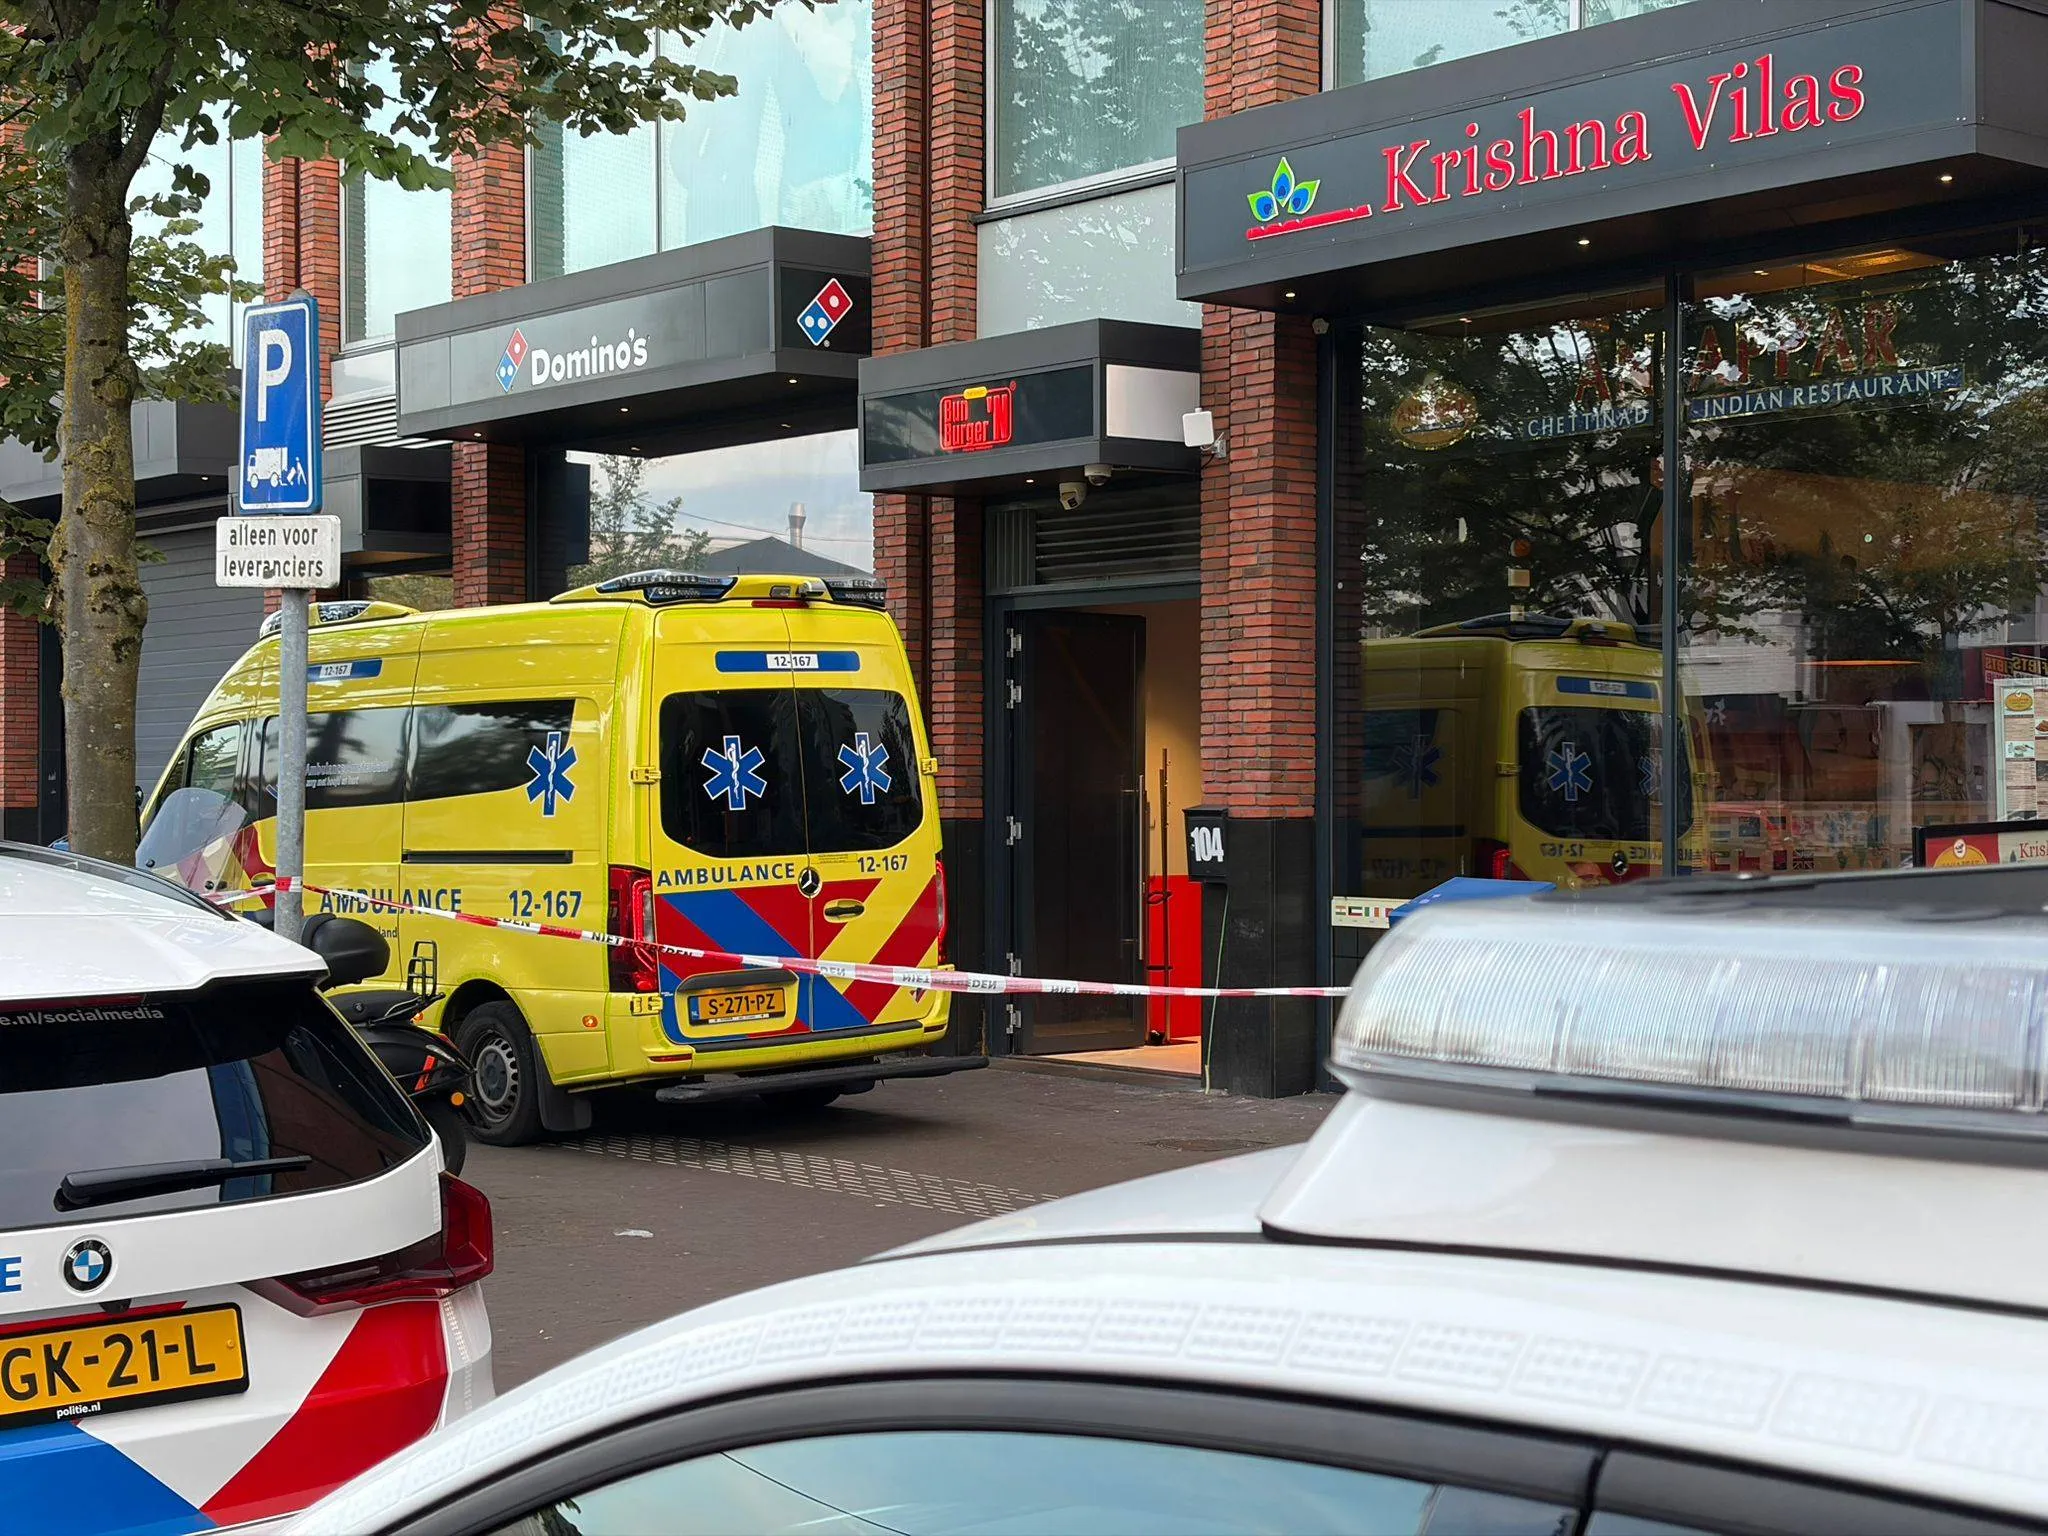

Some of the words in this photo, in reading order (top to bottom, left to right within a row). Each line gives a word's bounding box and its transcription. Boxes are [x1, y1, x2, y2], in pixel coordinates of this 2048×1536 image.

[1381, 106, 1653, 213] Krishna
[1670, 53, 1866, 152] Vilas
[531, 327, 649, 386] Domino's
[257, 329, 292, 421] P
[1703, 389, 1784, 418] INDIAN
[1792, 369, 1946, 407] RESTAURANT
[944, 398, 969, 423] Bun
[1527, 408, 1650, 438] CHETTINAD
[944, 420, 989, 447] Burger
[229, 523, 277, 546] alleen
[282, 527, 319, 546] voor
[223, 554, 324, 579] leveranciers
[323, 664, 348, 676] 12-167
[773, 655, 812, 667] 12-167
[1190, 826, 1225, 862] 104
[656, 862, 796, 887] AMBULANCE
[857, 854, 908, 873] 12-167
[320, 888, 462, 915] AMBULANCE
[508, 890, 583, 918] 12-167
[376, 925, 398, 939] land
[591, 931, 622, 946] NIET
[0, 1006, 165, 1026] e.nl/socialmedia
[708, 993, 776, 1016] S-271-PZ
[0, 1324, 216, 1401] GK-21-L
[56, 1402, 101, 1419] politie.nl
